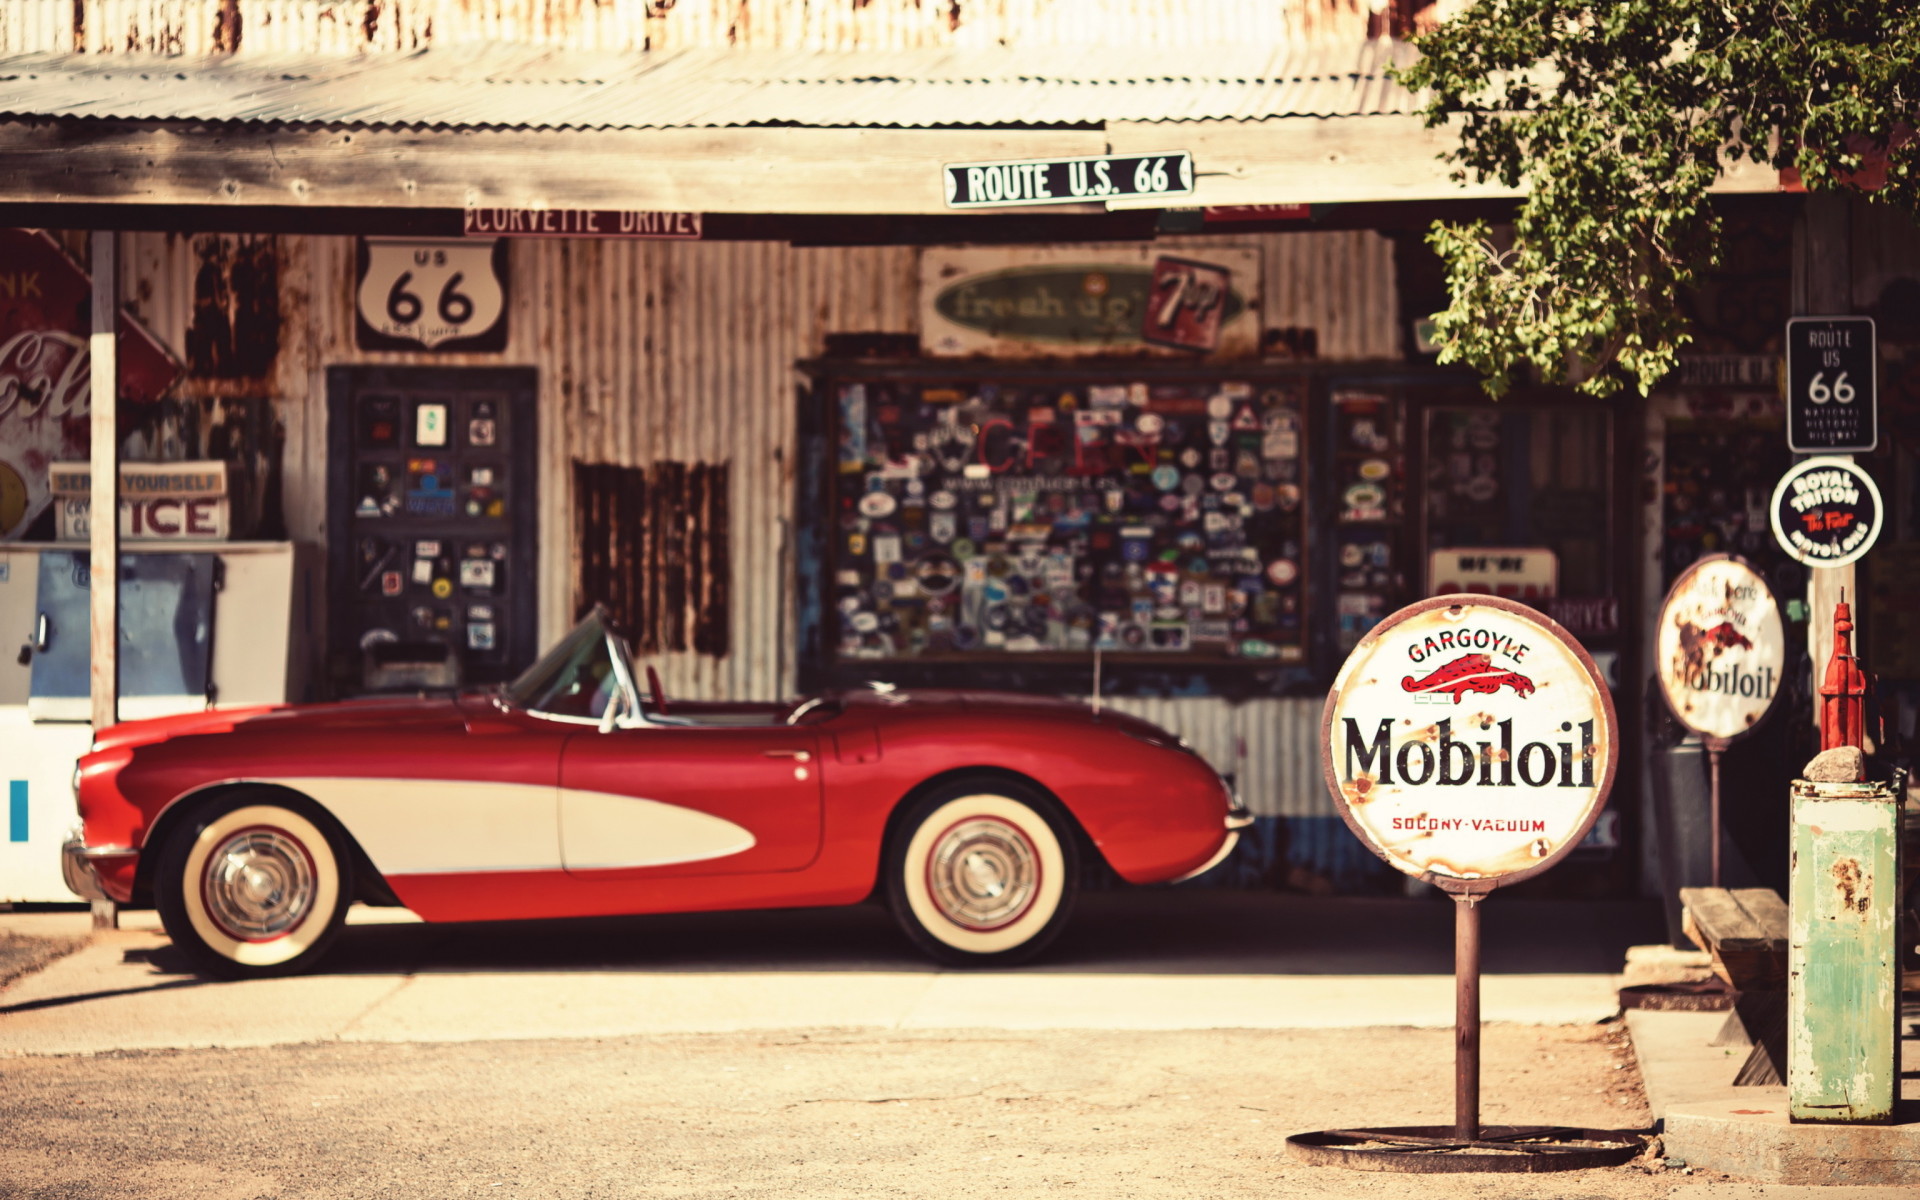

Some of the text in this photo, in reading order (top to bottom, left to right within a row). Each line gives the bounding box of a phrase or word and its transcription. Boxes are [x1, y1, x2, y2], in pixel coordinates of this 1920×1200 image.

[968, 157, 1169, 202] ROUTE U.S. 66
[475, 208, 690, 234] CORVETTE DRIVE
[414, 249, 447, 267] US
[386, 269, 475, 325] 66
[955, 287, 1067, 317] fresh
[1808, 330, 1852, 348] ROUTE
[1822, 350, 1840, 368] US
[1808, 371, 1856, 404] 66
[1804, 407, 1860, 417] NATIONAL
[1805, 420, 1859, 430] HISTORIC
[1808, 430, 1857, 440] HIGHWAY
[123, 474, 216, 491] YOURSELF
[1792, 470, 1854, 494] ROYAL
[1789, 486, 1860, 513] TRITON
[131, 497, 217, 535] ICE
[1790, 521, 1869, 558] MOTOR OILS
[1407, 627, 1530, 665] GARGOYLE
[1341, 716, 1598, 788] Mobiloil
